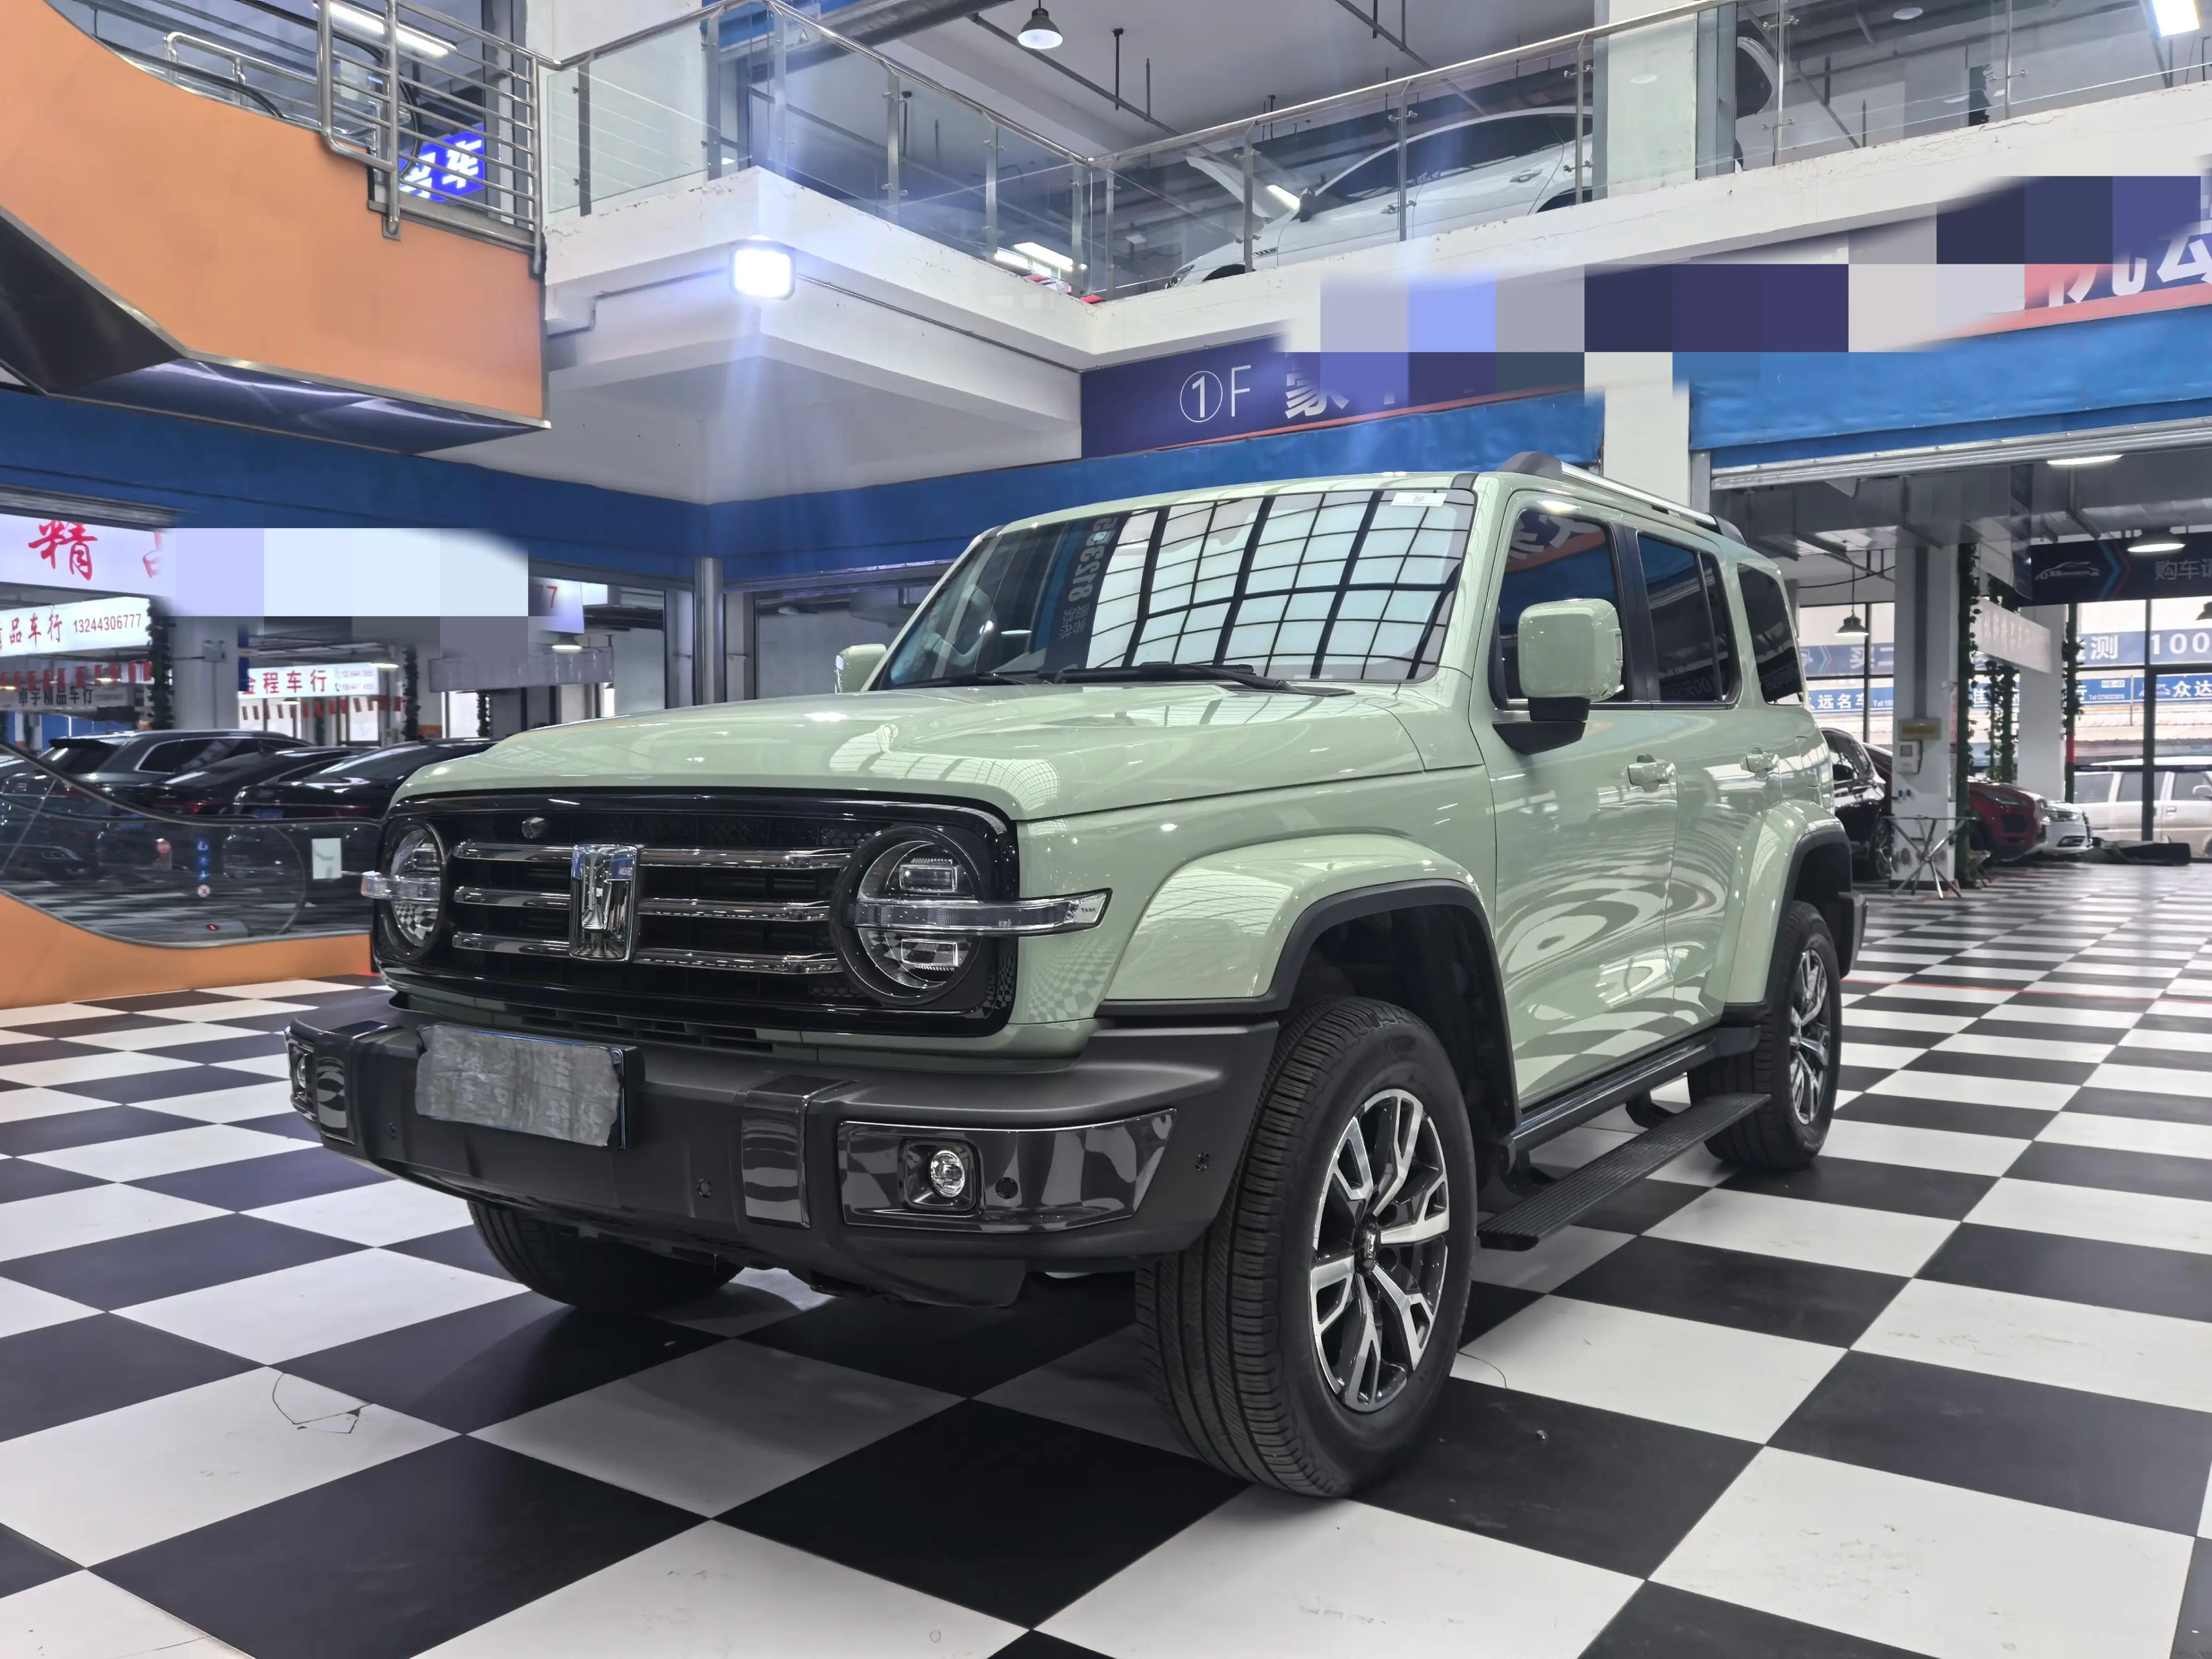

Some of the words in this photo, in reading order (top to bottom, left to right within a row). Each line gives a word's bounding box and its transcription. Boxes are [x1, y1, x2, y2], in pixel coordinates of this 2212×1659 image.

[0, 612, 63, 648] 品车行
[73, 613, 142, 633] 13244306777
[2172, 680, 2212, 698] 众达
